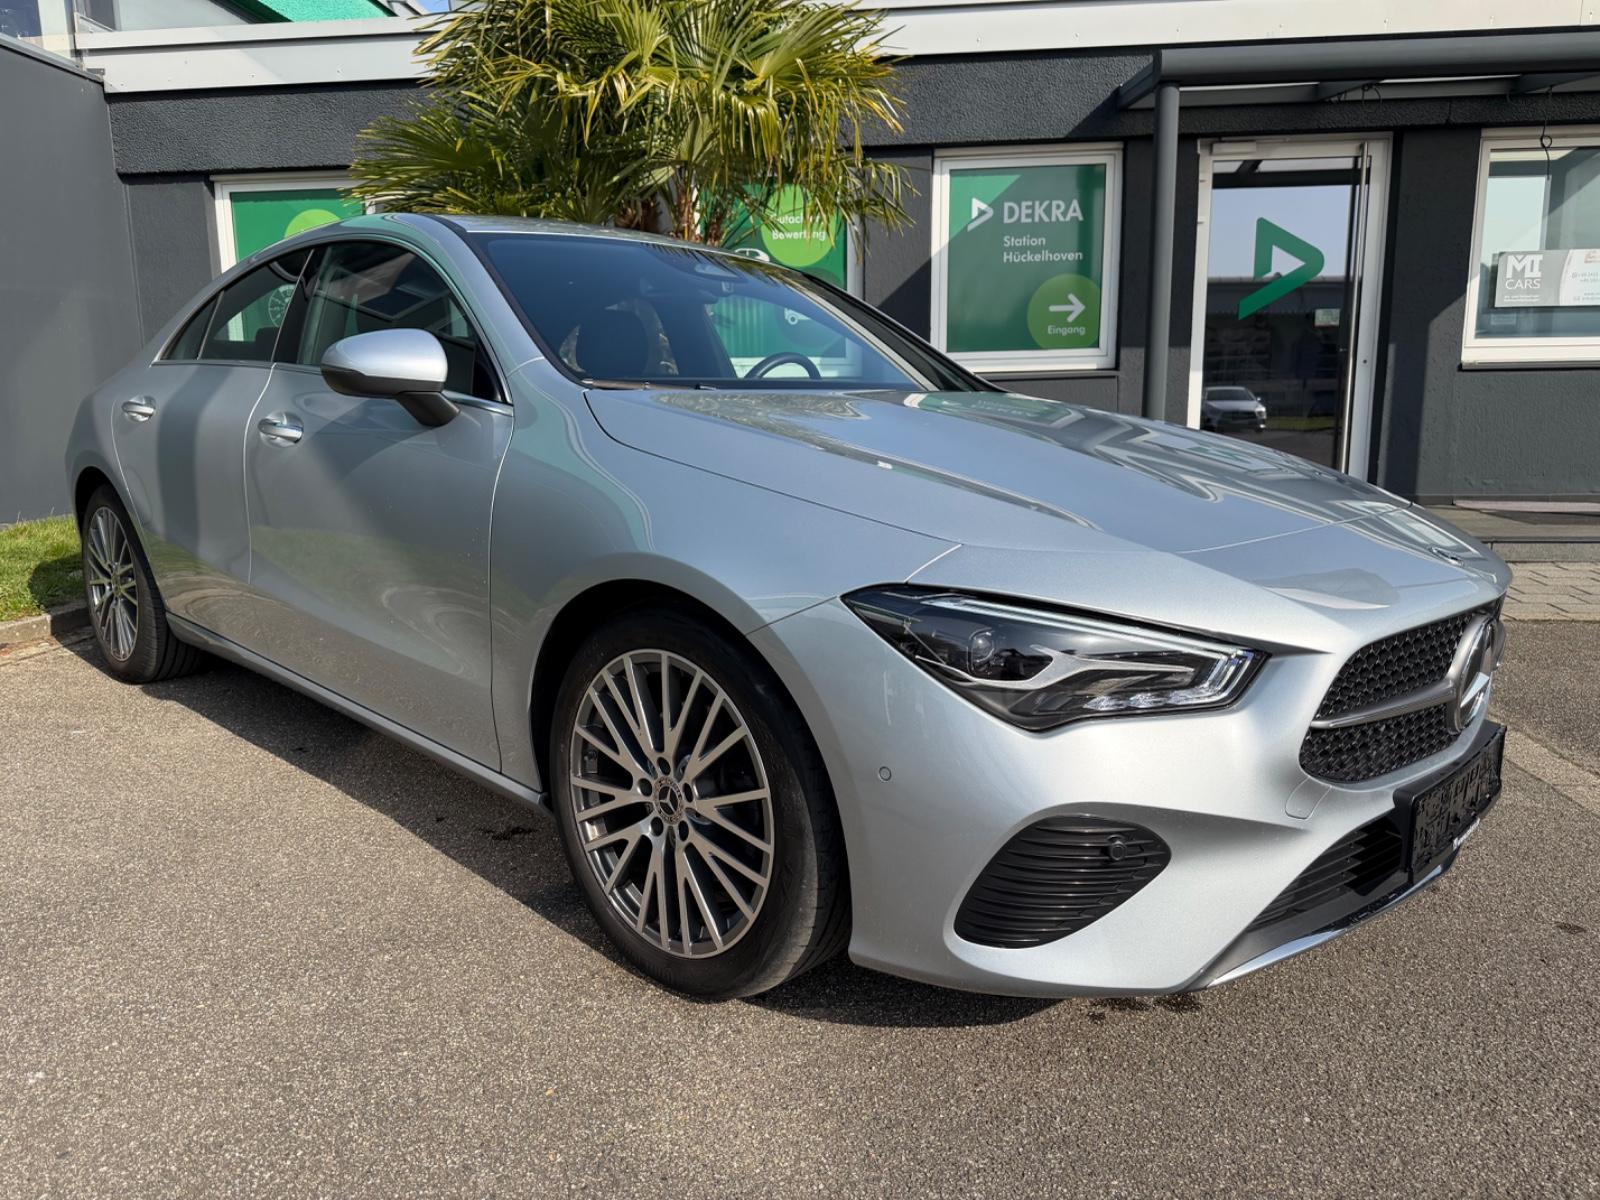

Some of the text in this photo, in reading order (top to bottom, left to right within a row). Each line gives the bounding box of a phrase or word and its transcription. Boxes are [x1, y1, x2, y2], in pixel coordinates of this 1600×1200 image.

[1003, 199, 1083, 224] DEKRA
[772, 230, 827, 241] Bewertng
[1003, 235, 1046, 247] Station
[1003, 250, 1083, 263] Hückelhoven
[1505, 279, 1541, 290] CARS
[1047, 325, 1086, 337] Eingang
